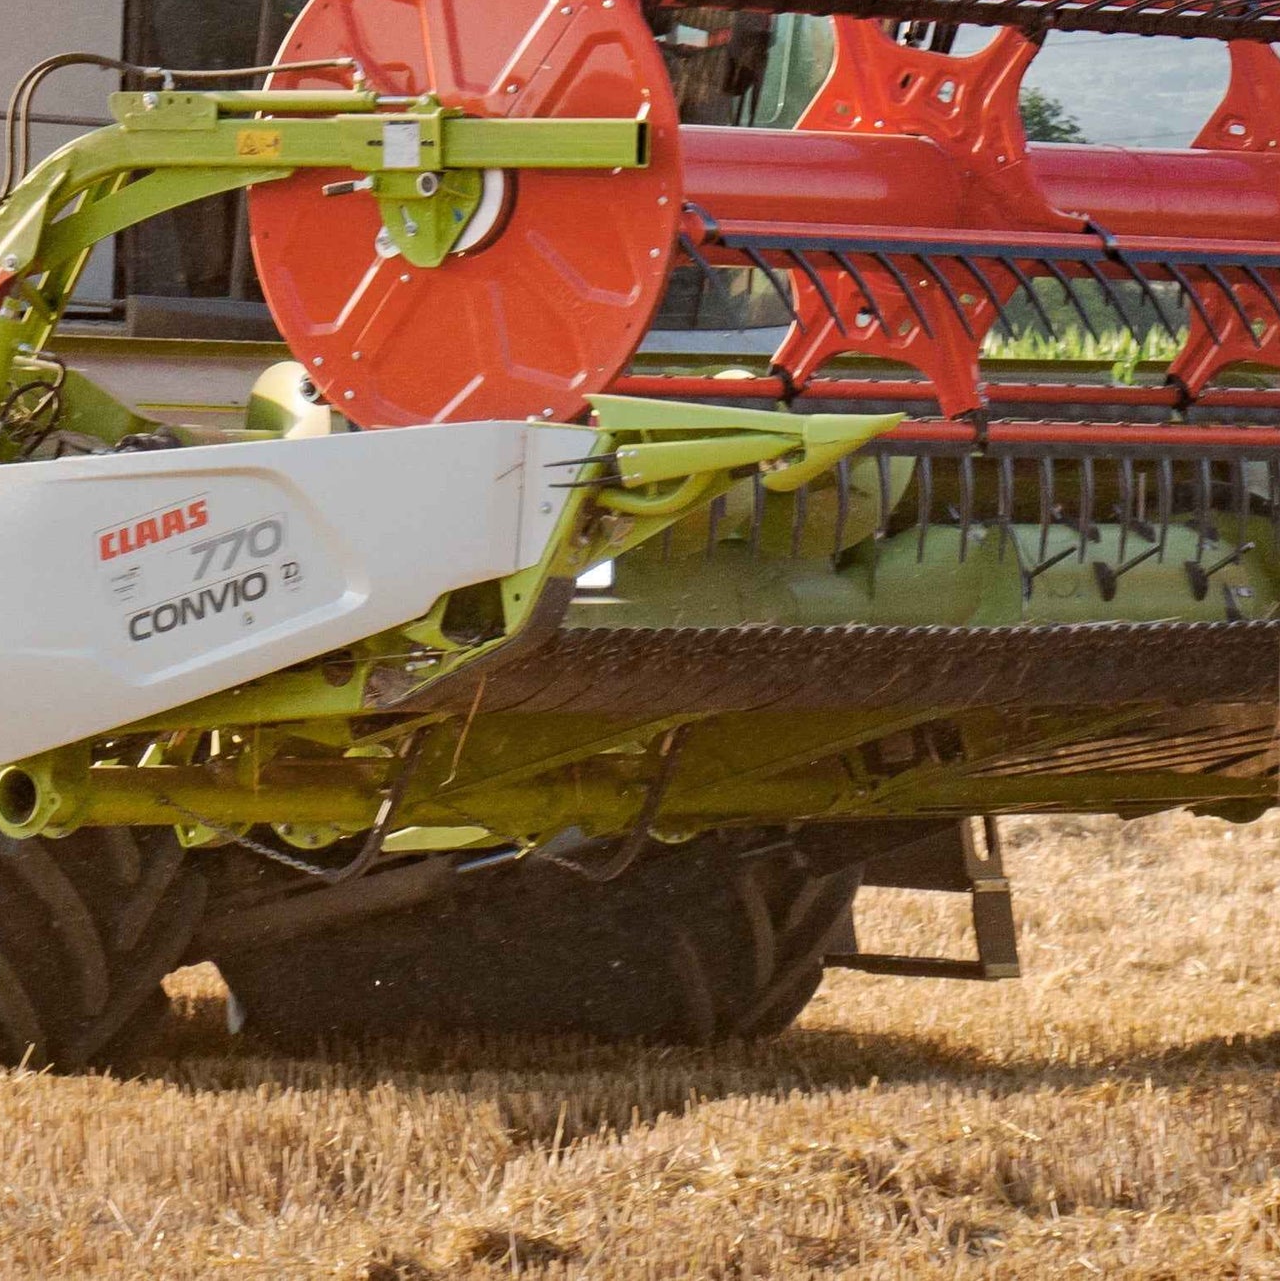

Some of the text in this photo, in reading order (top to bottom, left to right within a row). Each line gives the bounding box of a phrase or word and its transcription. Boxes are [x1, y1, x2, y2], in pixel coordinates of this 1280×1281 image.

[99, 498, 209, 562] CLAAS
[190, 519, 283, 581] 770
[128, 571, 268, 642] CONVIO
